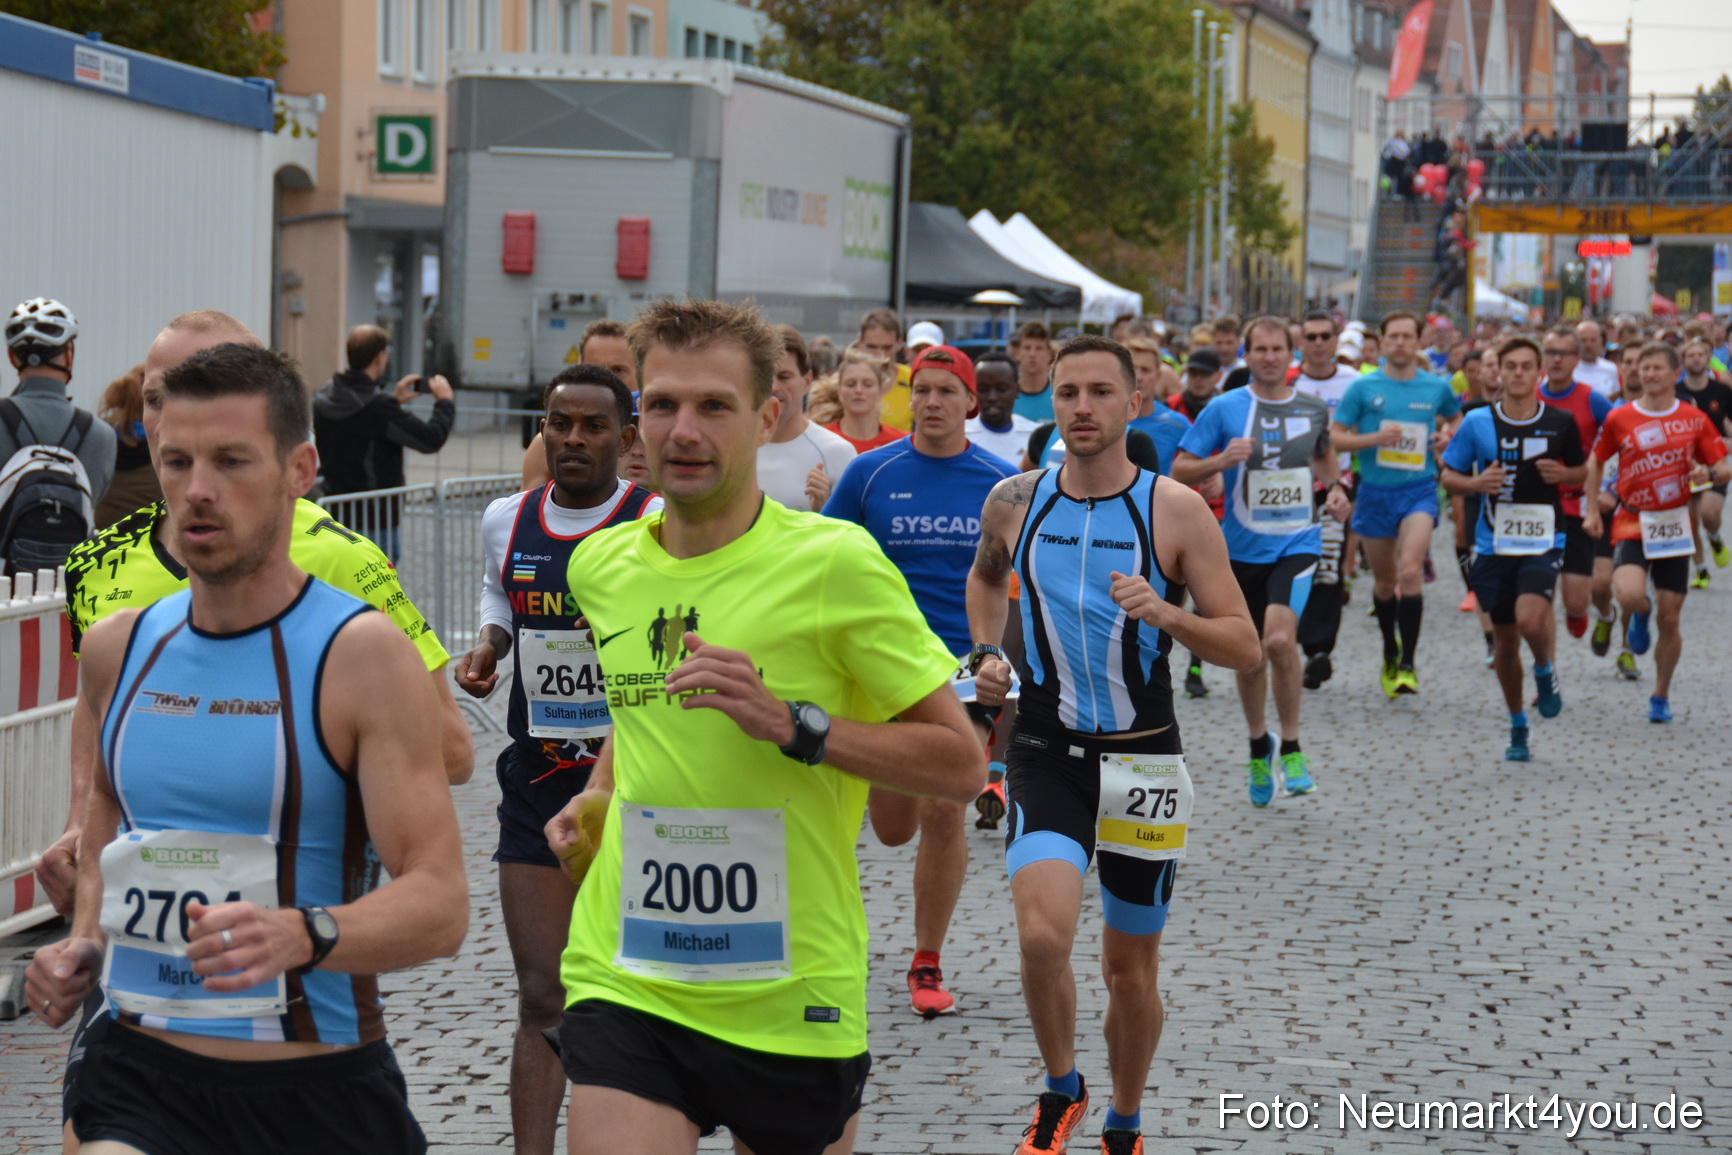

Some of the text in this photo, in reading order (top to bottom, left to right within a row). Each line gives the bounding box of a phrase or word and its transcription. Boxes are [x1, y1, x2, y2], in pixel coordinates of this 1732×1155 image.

[385, 123, 427, 168] D
[1259, 487, 1303, 505] 2284
[891, 516, 981, 535] SYSCAD
[1504, 520, 1545, 536] 2135
[1648, 523, 1683, 539] 2435
[544, 706, 577, 719] Sultan
[1126, 787, 1178, 819] 275
[669, 825, 729, 840] BOCK
[1136, 828, 1165, 842] Lukas
[155, 848, 219, 864] BOCK
[642, 859, 758, 914] 2000
[628, 901, 634, 910] B
[664, 930, 730, 951] Michael
[158, 962, 212, 986] Marc
